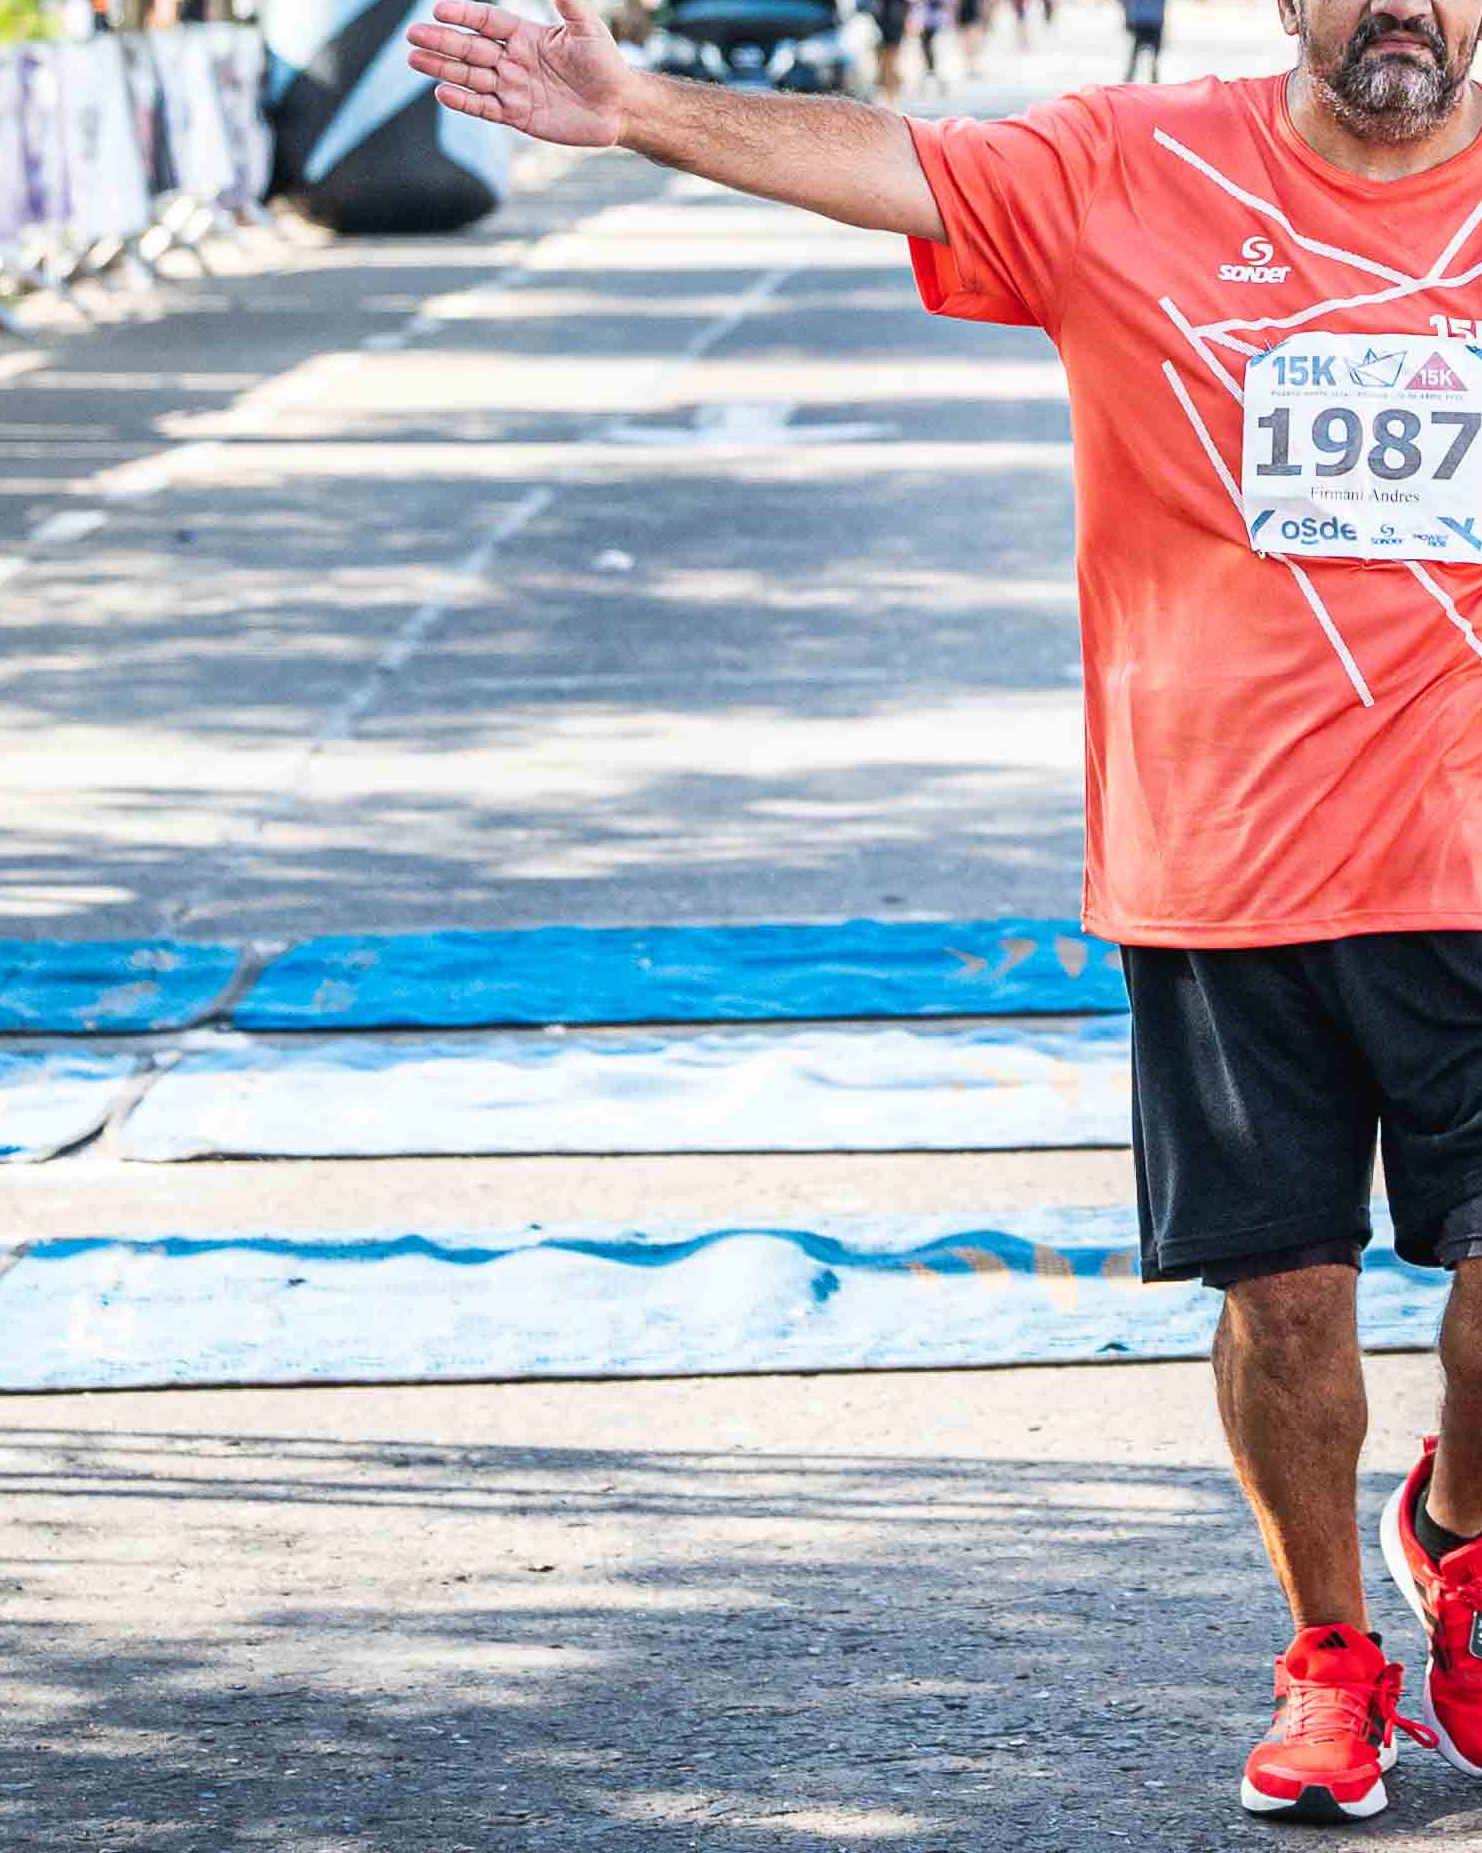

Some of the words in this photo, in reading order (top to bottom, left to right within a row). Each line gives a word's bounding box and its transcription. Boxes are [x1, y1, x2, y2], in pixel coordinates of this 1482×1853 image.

[1271, 354, 1337, 387] 15K
[1418, 366, 1455, 387] 15K
[1256, 407, 1482, 480] 1987
[1369, 488, 1420, 503] Andres
[1281, 516, 1357, 545] osde
